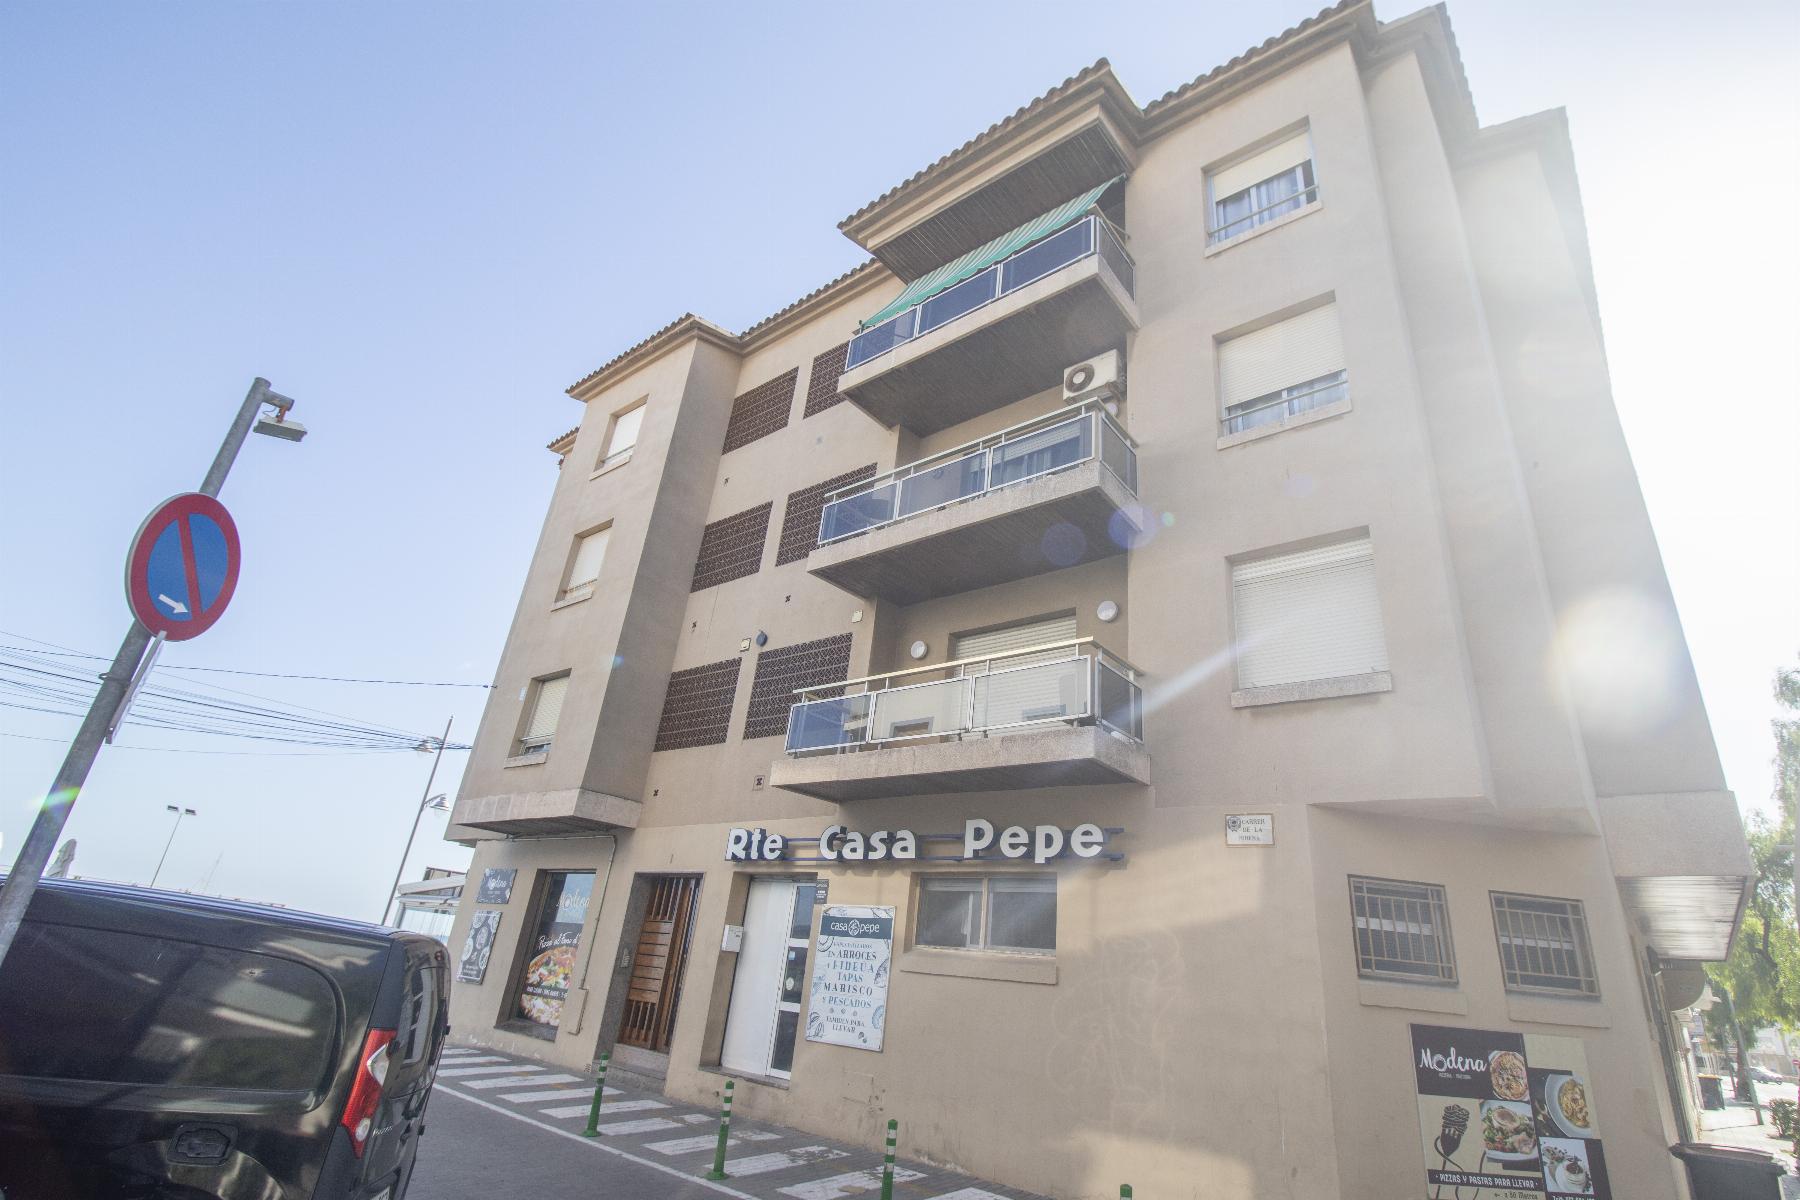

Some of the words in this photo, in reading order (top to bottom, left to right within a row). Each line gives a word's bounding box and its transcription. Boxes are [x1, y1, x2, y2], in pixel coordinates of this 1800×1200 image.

[725, 828, 783, 860] Rte
[819, 824, 916, 860] Casa
[963, 818, 1104, 864] Pepe
[830, 921, 848, 932] casa
[860, 923, 880, 935] pepe
[837, 949, 878, 961] ARROCES
[837, 971, 864, 983] TAPAS
[824, 982, 873, 997] MARISCO
[828, 995, 872, 1009] PESCADOS
[1419, 1046, 1488, 1072] Modena
[1439, 1173, 1461, 1183] PIZZAS
[1468, 1175, 1493, 1186] PASTAS
[1494, 1178, 1511, 1187] PARA
[1512, 1179, 1535, 1189] LLEVAR
